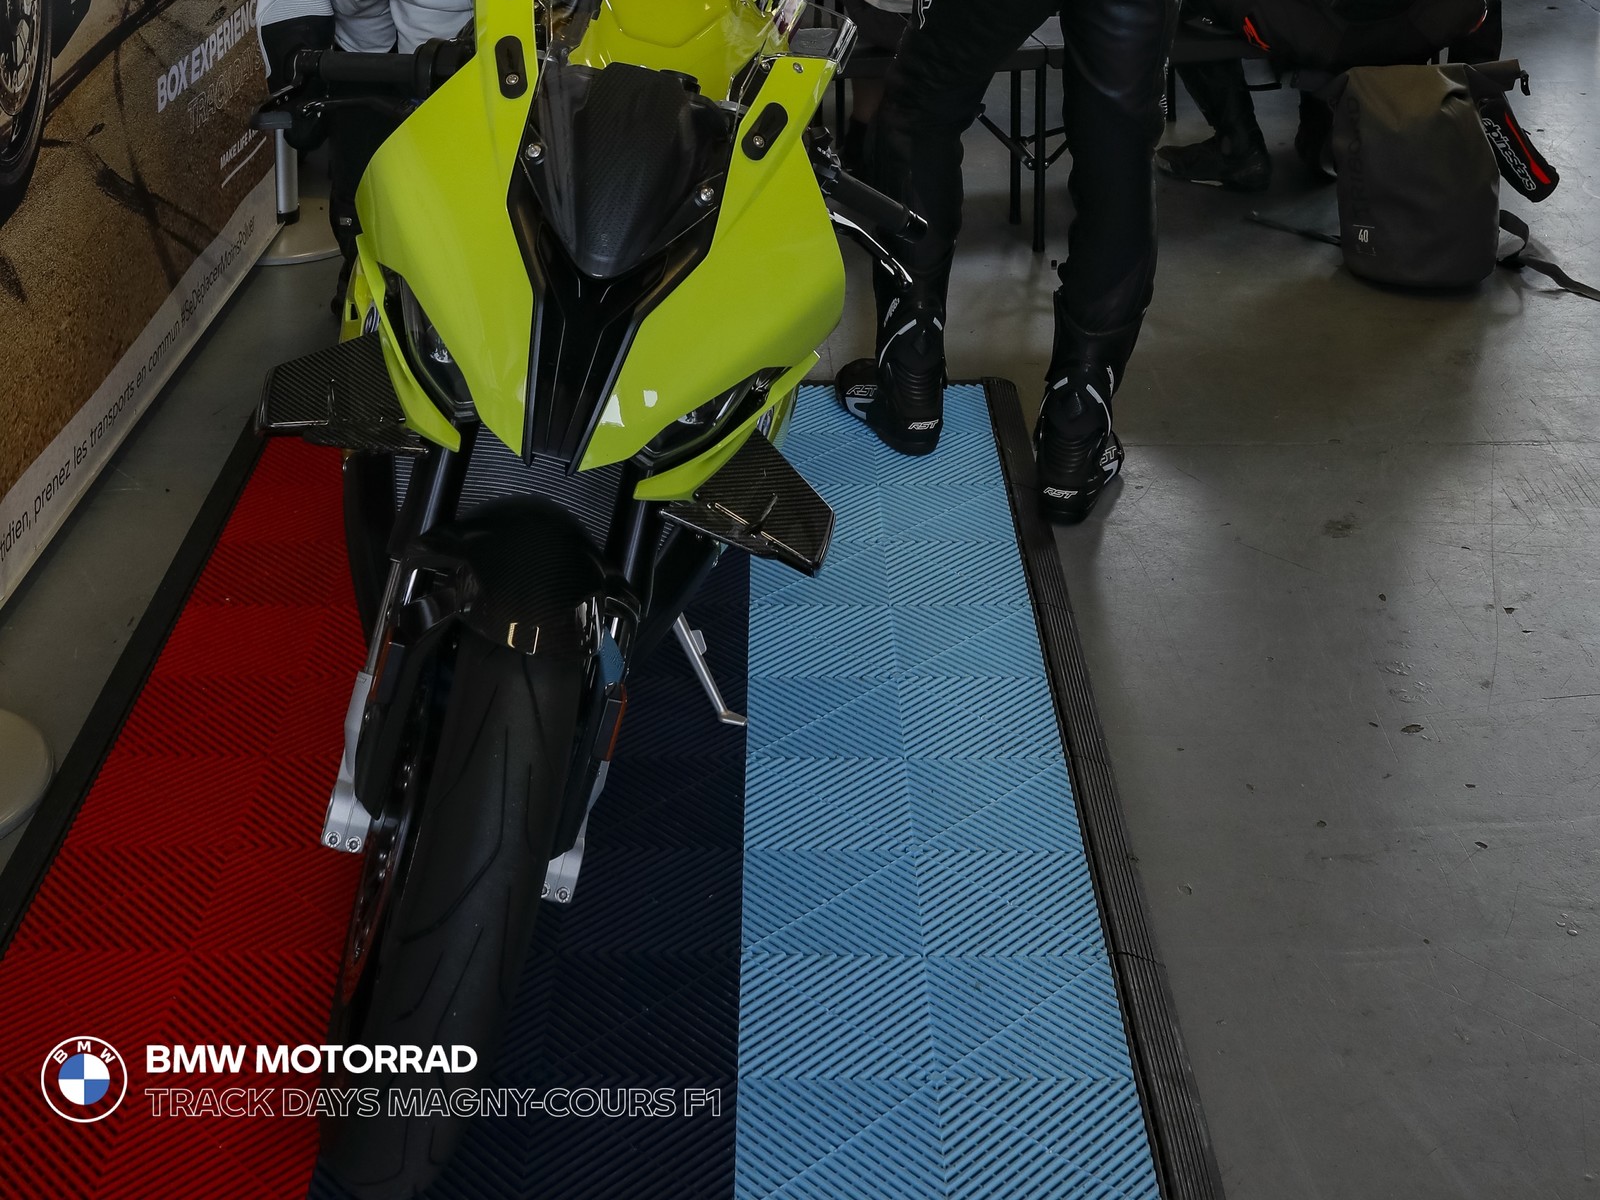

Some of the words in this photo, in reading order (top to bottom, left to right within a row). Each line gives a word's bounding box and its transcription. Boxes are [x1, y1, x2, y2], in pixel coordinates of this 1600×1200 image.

[157, 54, 190, 114] BOX
[1357, 228, 1370, 244] 40
[846, 384, 879, 397] RST
[33, 458, 71, 524] prenez
[73, 439, 88, 470] les
[90, 380, 134, 448] transports
[136, 365, 147, 389] en
[148, 320, 181, 373] commun
[907, 419, 940, 431] RST
[1043, 486, 1079, 500] RST
